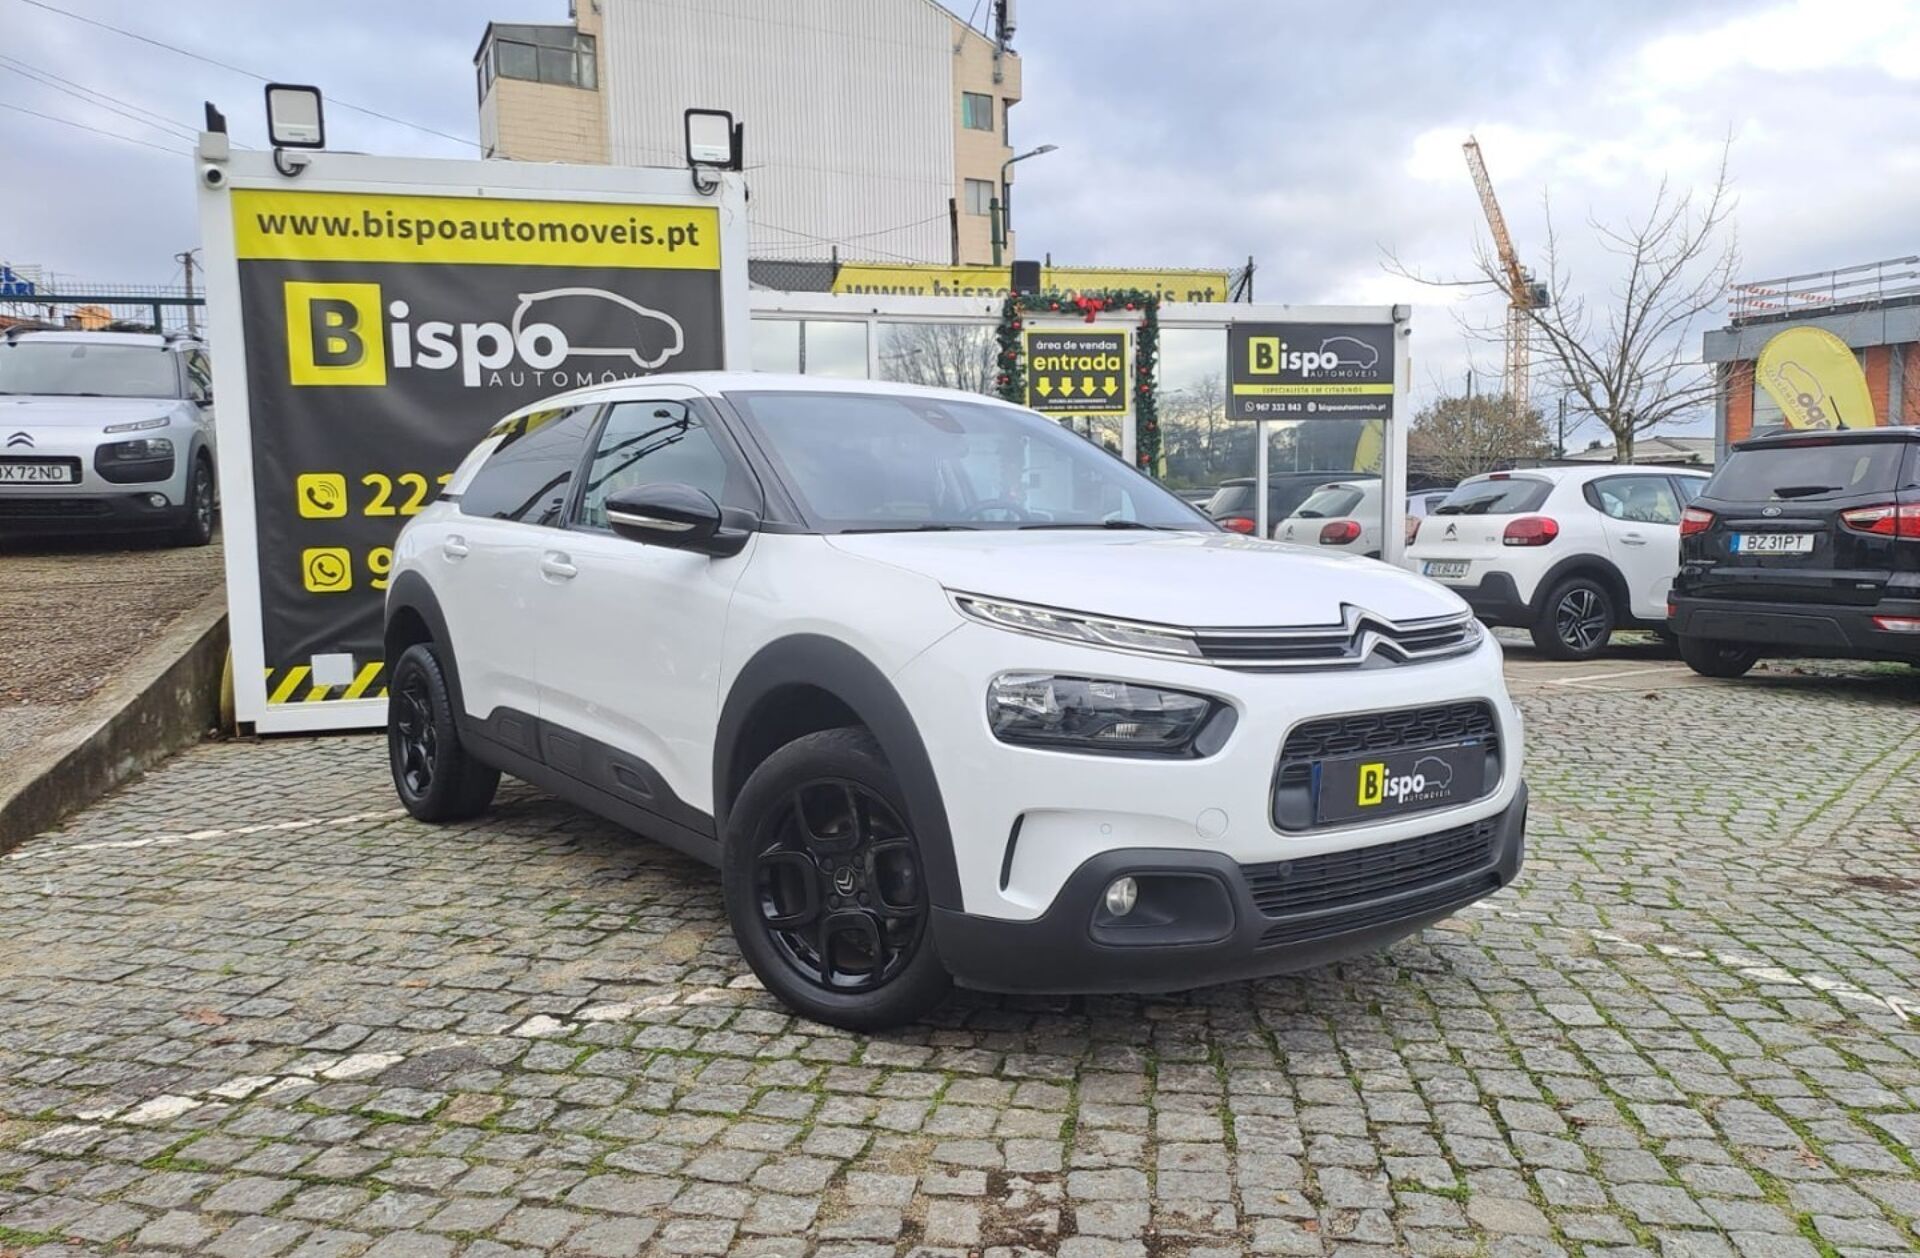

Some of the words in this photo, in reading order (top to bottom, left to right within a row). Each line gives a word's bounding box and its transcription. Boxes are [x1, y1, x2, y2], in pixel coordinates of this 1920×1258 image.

[257, 209, 700, 251] www.bispoautomoveis.pt
[308, 297, 569, 387] Bispo
[1036, 340, 1061, 350] área
[1063, 340, 1077, 350] de
[1080, 340, 1118, 350] vendas
[1256, 342, 1339, 378] Bispo
[488, 369, 652, 388] AUTOMÓ
[1033, 353, 1121, 371] entrada
[367, 547, 393, 590] 9
[1364, 767, 1426, 804] Bispo
